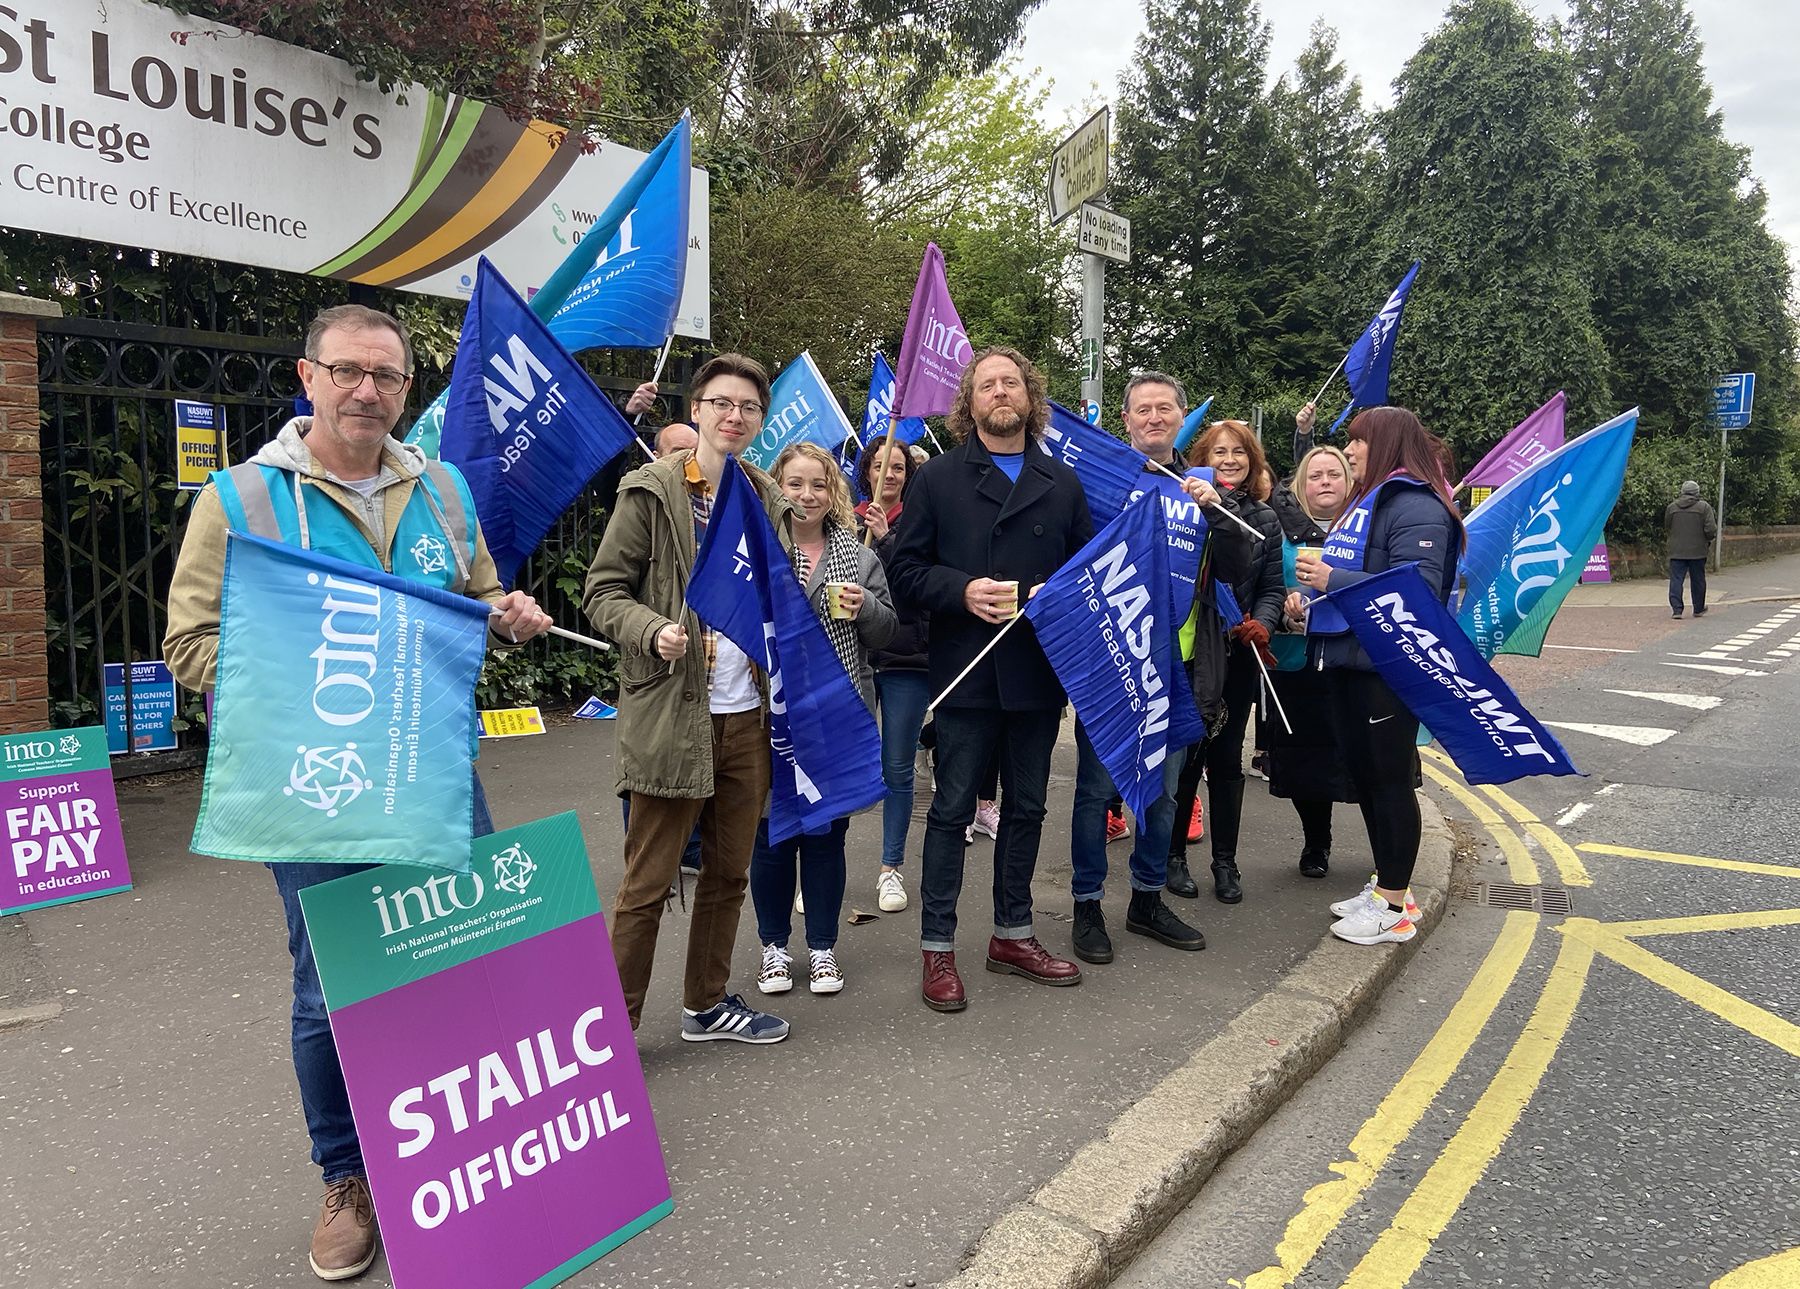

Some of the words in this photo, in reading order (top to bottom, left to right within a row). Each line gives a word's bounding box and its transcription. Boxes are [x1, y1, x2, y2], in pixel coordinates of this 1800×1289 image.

[92, 31, 383, 160] Louise's
[1073, 125, 1105, 165] Louise's
[1066, 166, 1096, 199] College
[13, 163, 118, 205] Centre
[129, 186, 160, 213] of
[169, 191, 308, 240] Excellence
[1085, 211, 1097, 227] No
[1099, 215, 1127, 239] loading
[1083, 231, 1092, 243] at
[1094, 235, 1109, 251] any
[1111, 236, 1128, 254] time
[187, 406, 214, 417] NASUWT
[181, 442, 218, 455] OFFICIA
[1167, 520, 1197, 537] Union
[1167, 534, 1196, 553] LAND
[1335, 532, 1358, 544] Union
[1588, 555, 1606, 563] AILC
[1077, 567, 1100, 614] The
[1098, 612, 1147, 713] Teachers'
[1364, 600, 1394, 635] The
[1394, 633, 1472, 703] Teachers'
[1468, 707, 1514, 758] Union
[1373, 592, 1556, 765] NASUWT
[108, 691, 172, 702] CAMAIGNING
[139, 701, 171, 710] BETTER
[4, 741, 55, 762] into
[18, 781, 80, 800] Support
[6, 798, 101, 840] FAIR
[12, 828, 102, 878] PAY
[19, 882, 34, 895] in
[38, 868, 111, 892] education
[372, 871, 485, 938] into
[385, 942, 408, 956] Irish
[409, 927, 448, 948] National
[448, 913, 489, 934] Teachers'
[489, 895, 543, 919] Organisation
[412, 943, 449, 960] Cumann
[450, 923, 494, 948] Múinteoirí
[494, 914, 526, 932] Éireann
[388, 1005, 615, 1159] STAILC
[411, 1089, 632, 1231] OIFIGIÚIL
